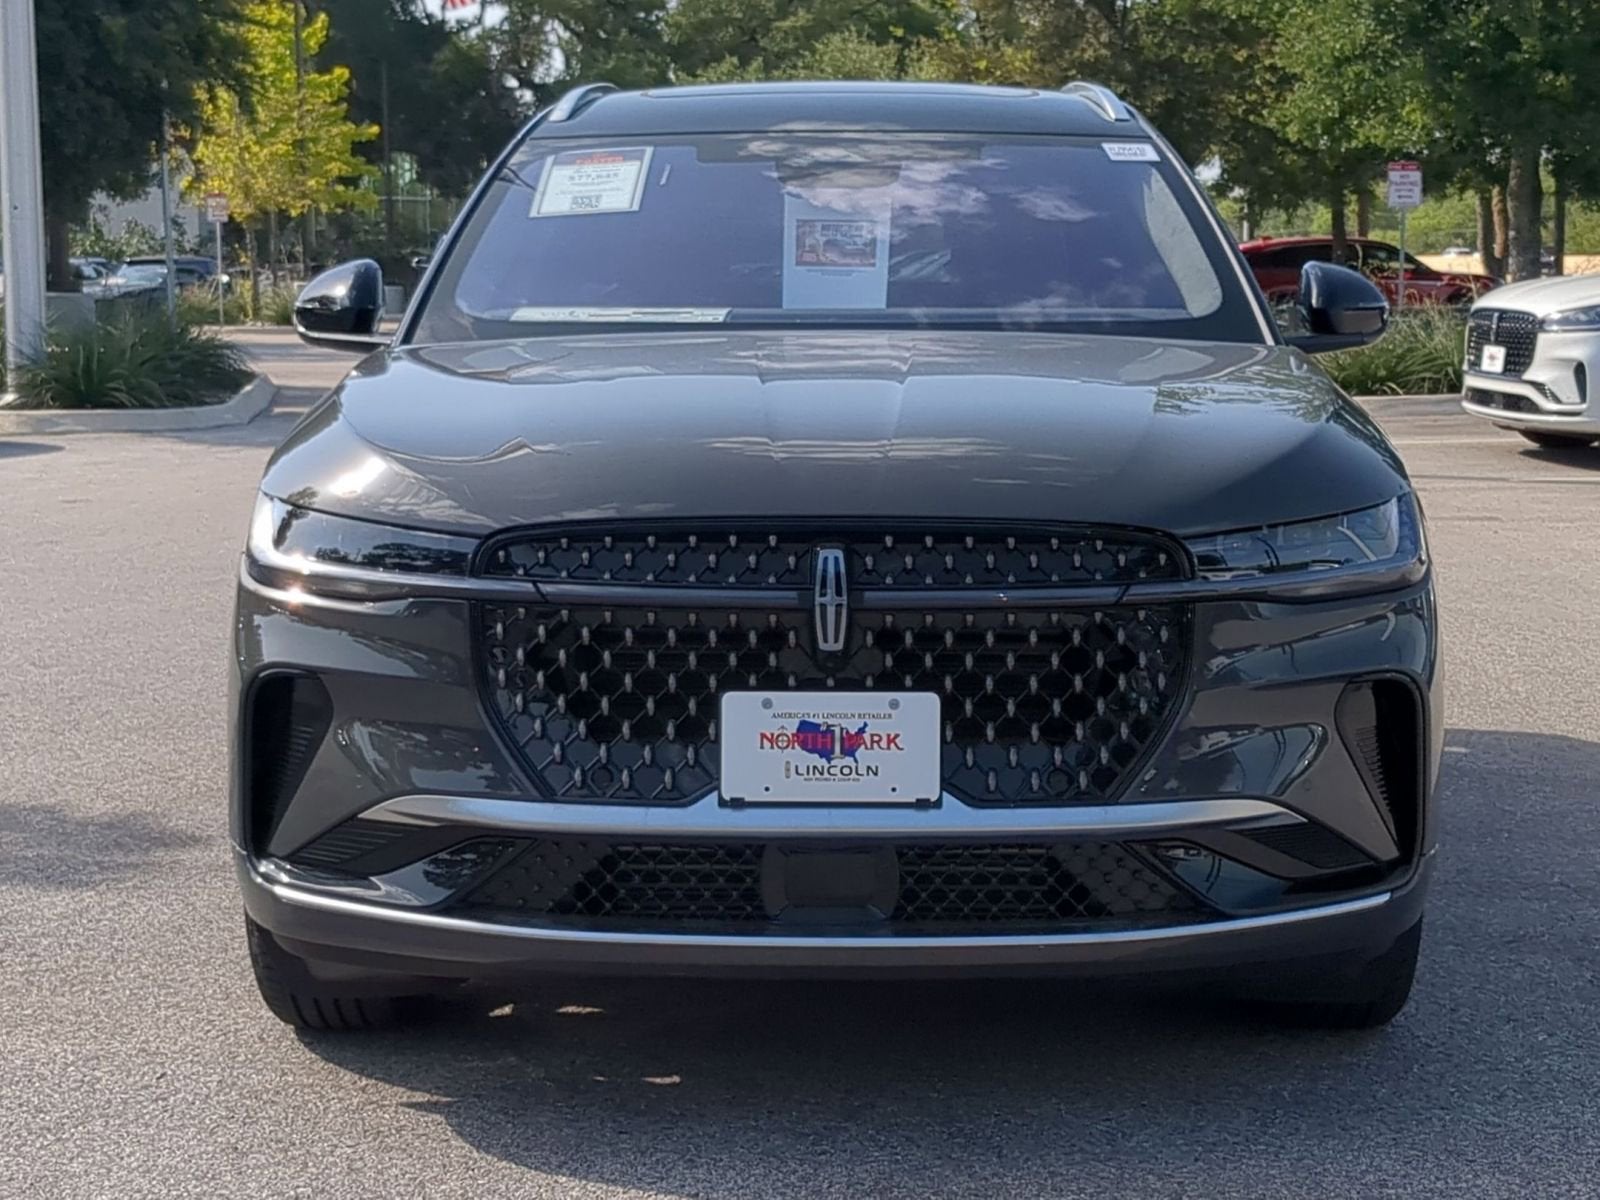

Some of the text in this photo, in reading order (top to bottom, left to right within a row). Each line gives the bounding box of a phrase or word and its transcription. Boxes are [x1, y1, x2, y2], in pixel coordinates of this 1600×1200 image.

[771, 712, 810, 720] AMERICA'S
[822, 712, 855, 720] LINCOLN
[857, 712, 893, 720] RETAILER
[759, 731, 904, 751] NORTH PARK
[794, 764, 879, 777] LINCOLN
